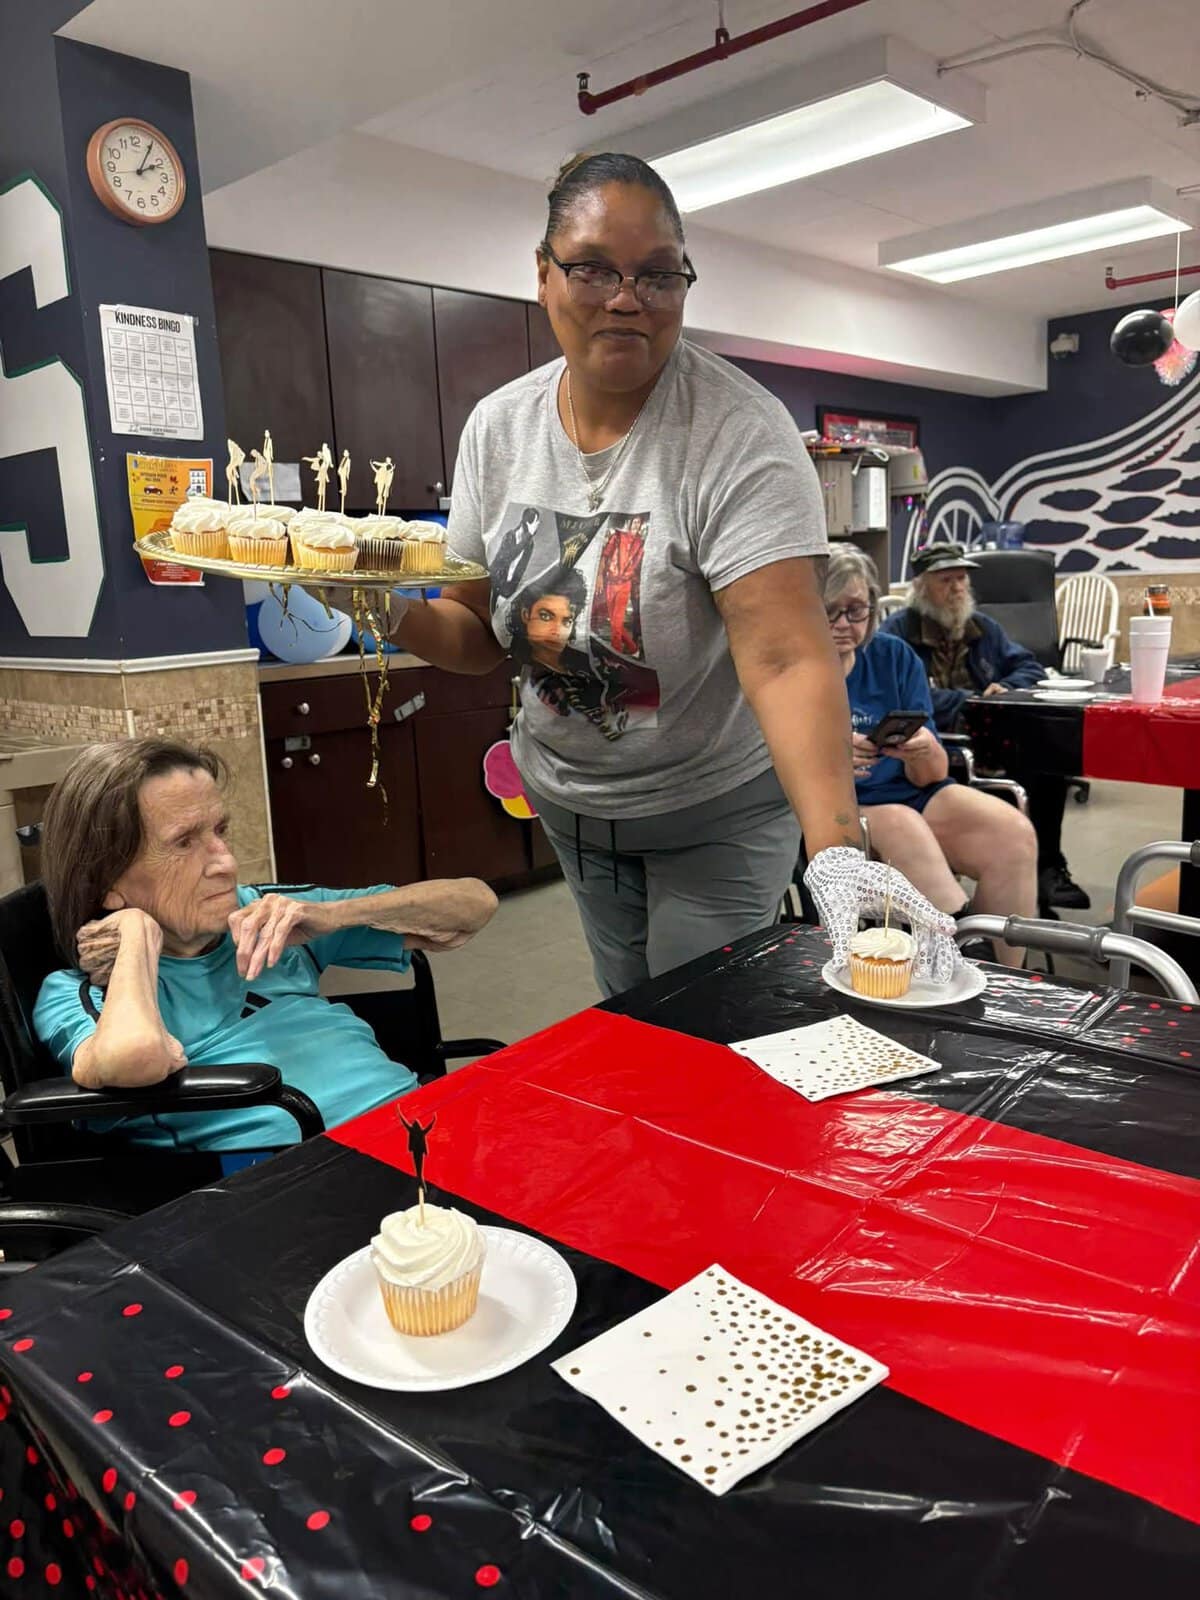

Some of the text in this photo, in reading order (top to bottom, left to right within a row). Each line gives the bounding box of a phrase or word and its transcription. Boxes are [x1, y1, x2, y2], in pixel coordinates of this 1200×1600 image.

[120, 138, 127, 150] 11
[129, 135, 140, 147] 12
[108, 147, 120, 159] 10
[107, 161, 116, 172] 9
[155, 158, 163, 169] 2
[113, 175, 122, 187] 8
[160, 172, 168, 183] 3
[125, 189, 132, 200] 7
[158, 186, 166, 196] 4
[137, 197, 145, 208] 6
[150, 195, 159, 206] 5
[115, 311, 180, 333] KINDNESS BINGO
